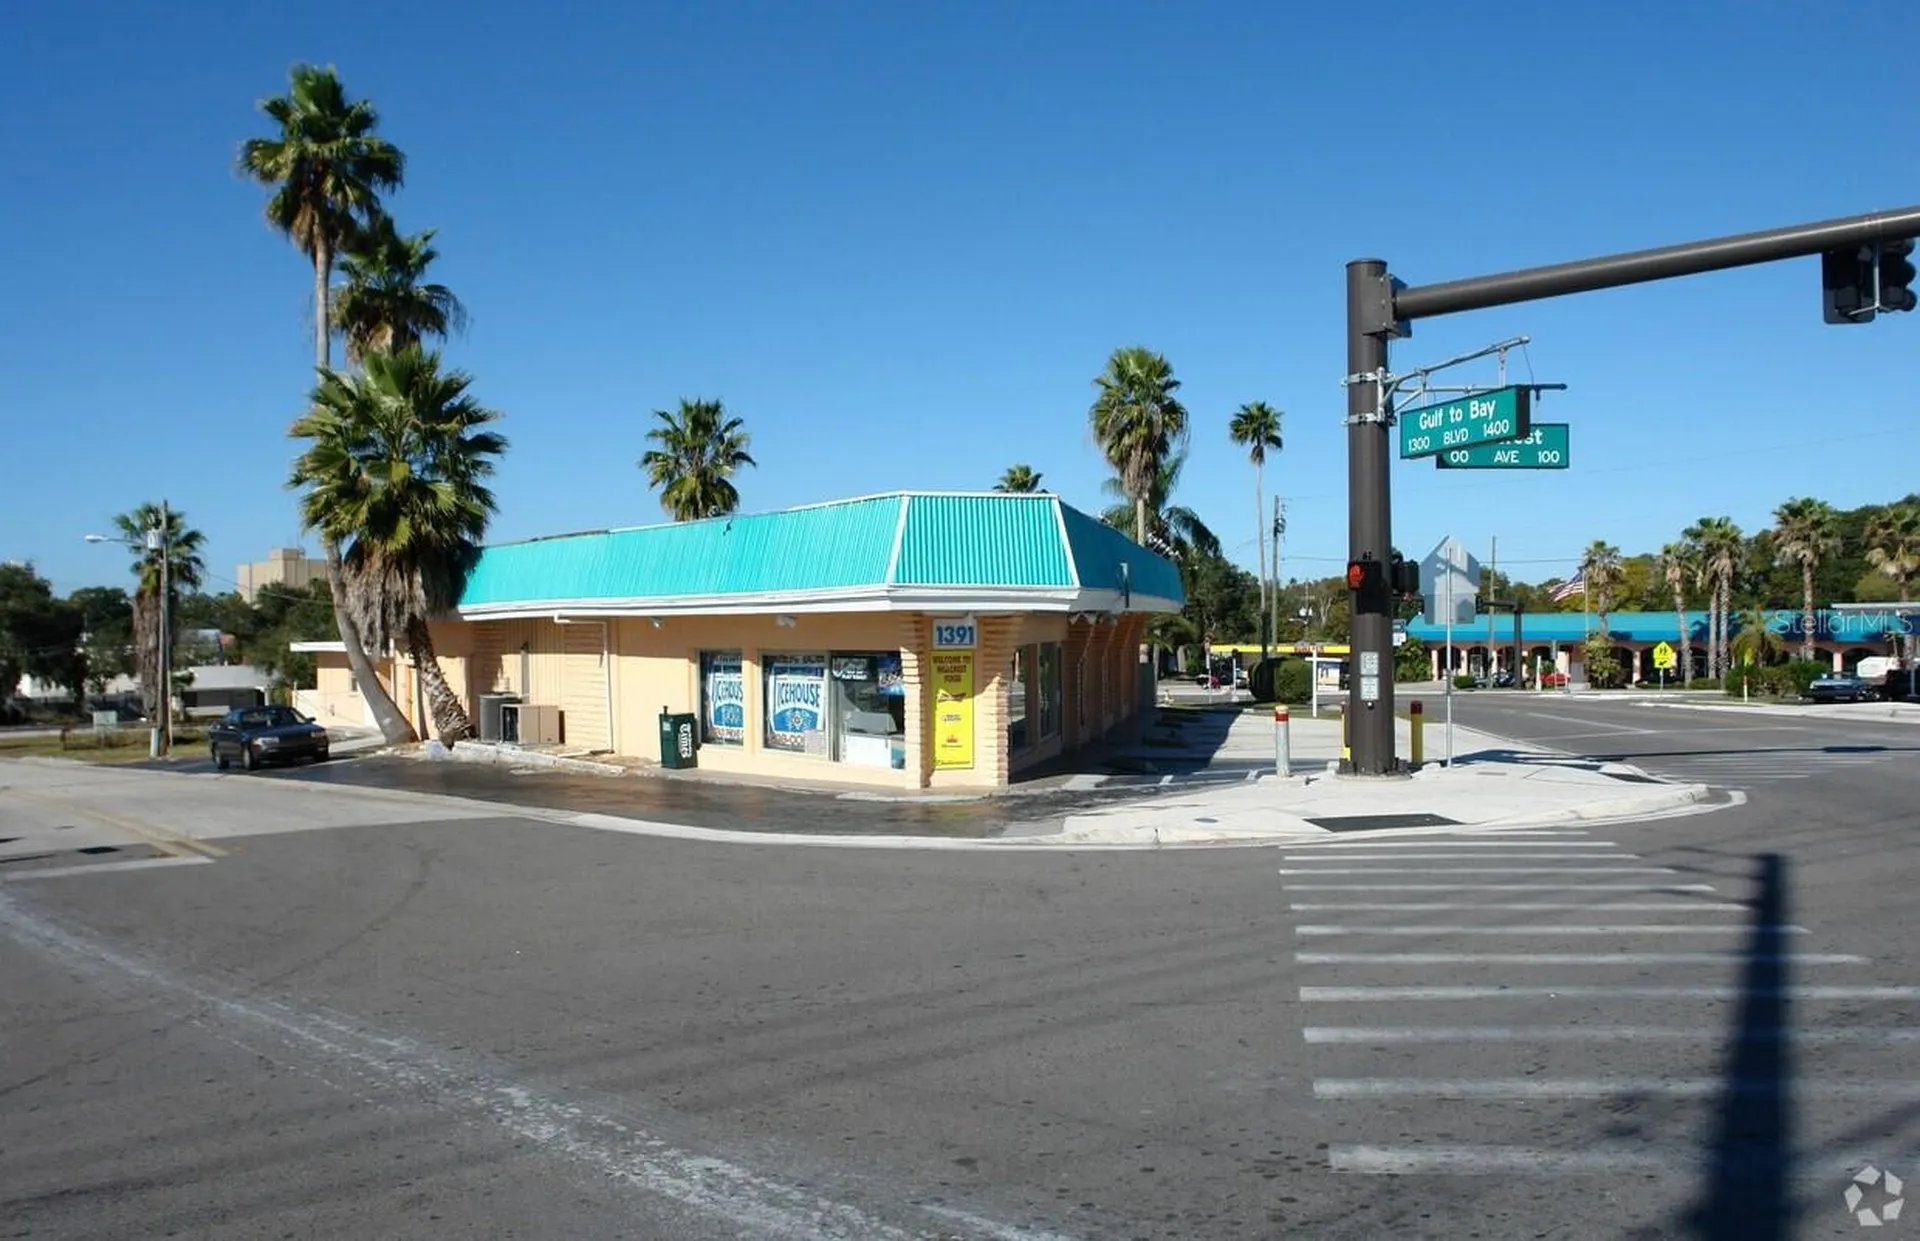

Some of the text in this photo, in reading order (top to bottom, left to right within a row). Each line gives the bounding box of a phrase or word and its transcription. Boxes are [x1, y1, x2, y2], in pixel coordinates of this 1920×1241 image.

[1419, 400, 1496, 430] Gulf to Bay
[1408, 436, 1430, 452] 1300
[1443, 428, 1469, 445] BLVD
[1483, 419, 1510, 437] 1400
[1450, 450, 1560, 463] 00 AVE 100
[936, 625, 974, 645] 1391
[715, 680, 743, 703] ICEHOUS
[777, 682, 821, 708] ICEHOUSE
